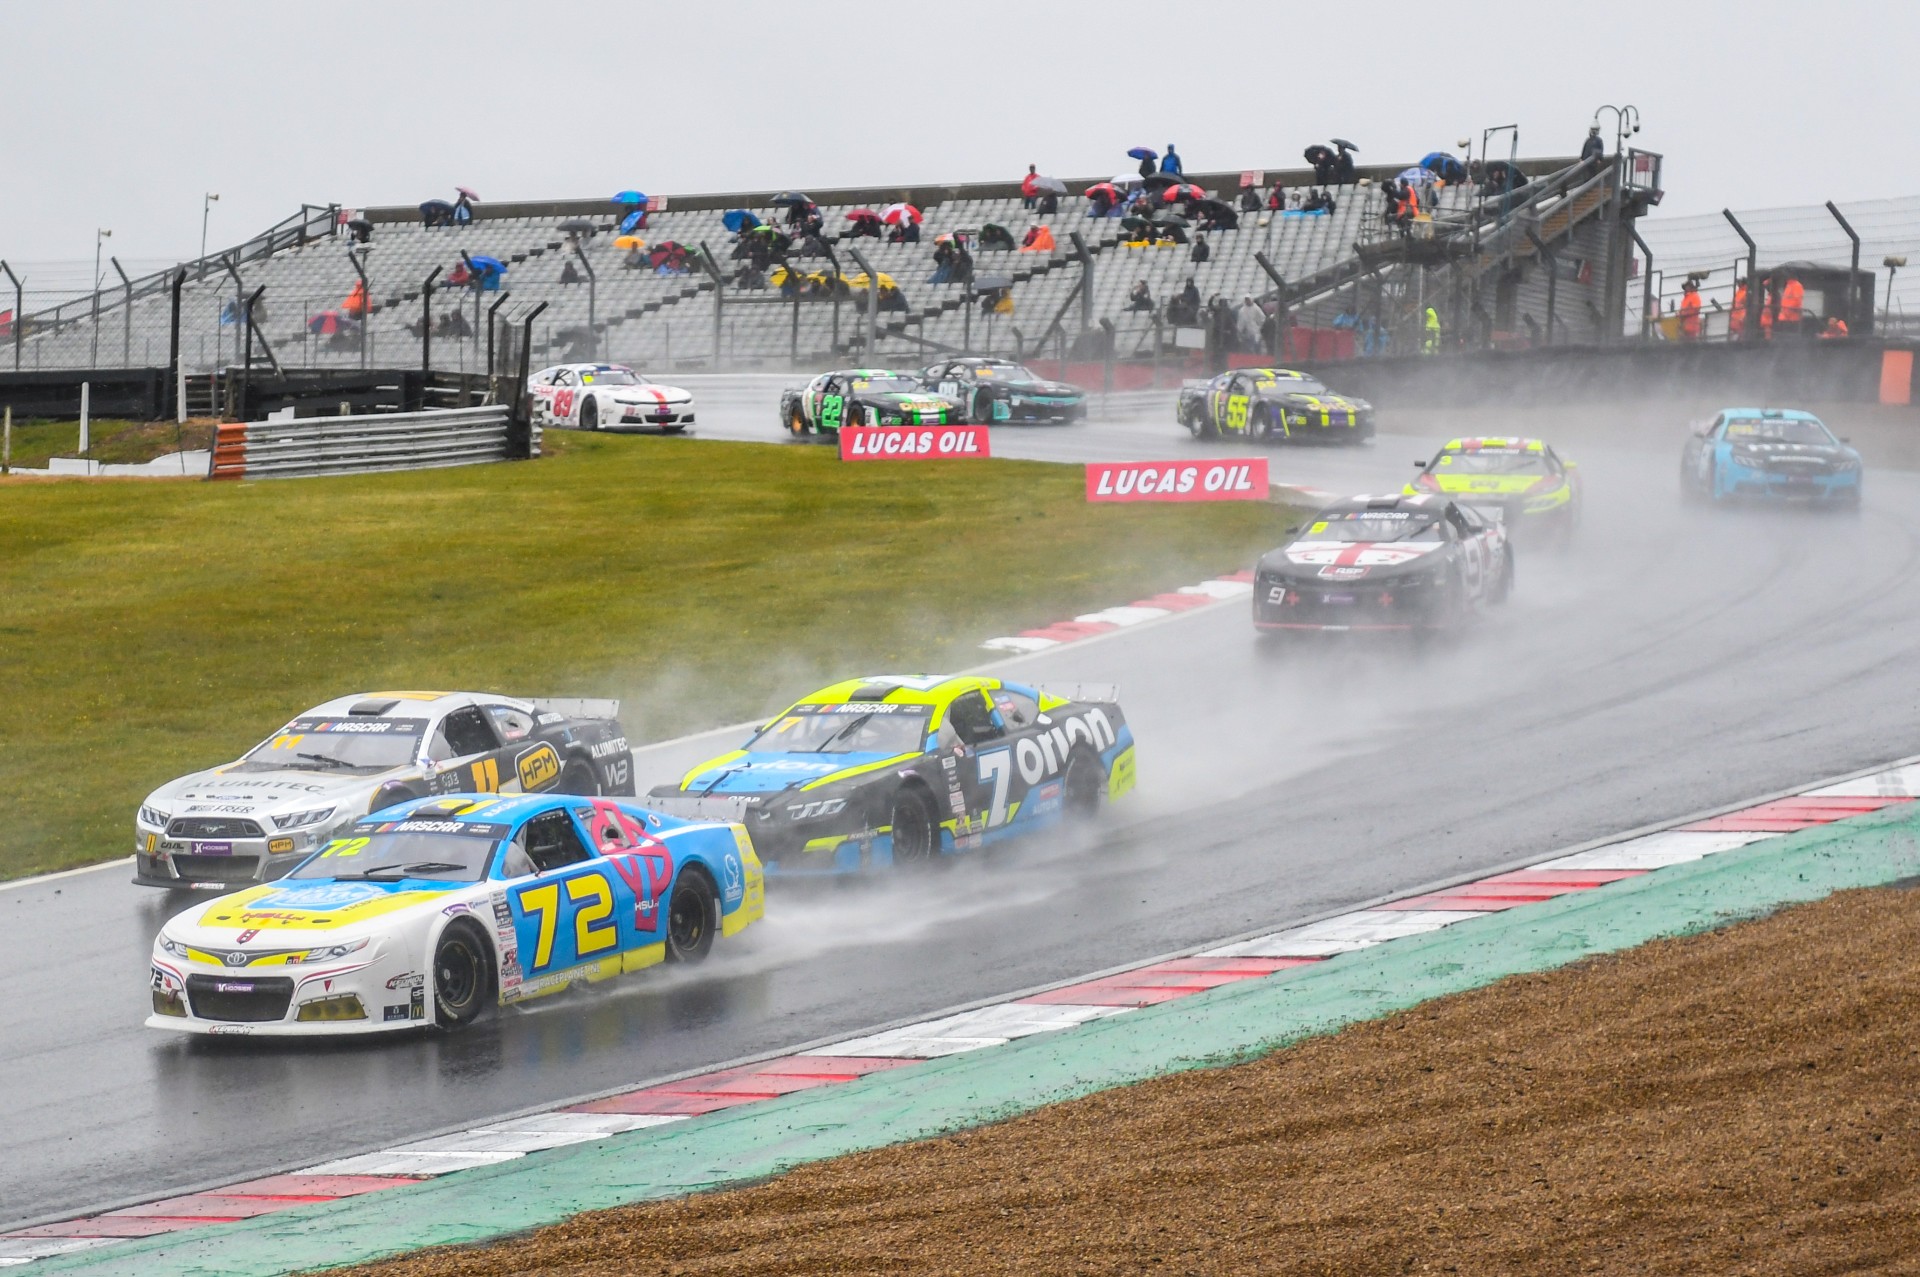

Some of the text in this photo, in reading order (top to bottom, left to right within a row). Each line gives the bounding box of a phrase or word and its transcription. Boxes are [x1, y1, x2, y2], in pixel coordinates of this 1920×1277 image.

[553, 389, 574, 417] 89
[822, 394, 843, 428] 22
[1226, 395, 1249, 428] 55
[852, 431, 979, 454] LUCAS OIL
[1096, 464, 1253, 496] LUCAS OIL
[1360, 512, 1410, 520] NASCAR
[1267, 586, 1286, 605] 9
[836, 704, 899, 714] NASCAR
[331, 722, 392, 733] NASCAR
[777, 716, 804, 734] 7
[271, 734, 305, 750] 11
[590, 737, 629, 760] ALUMITEC
[1016, 707, 1116, 786] orion
[471, 757, 499, 793] 11
[521, 750, 556, 785] HPM
[977, 746, 1011, 828] 7
[394, 821, 465, 833] NASCAR
[270, 840, 292, 850] HPM
[320, 836, 371, 859] 72
[518, 873, 618, 969] 72
[538, 963, 601, 990] RACEPLANET.NL
